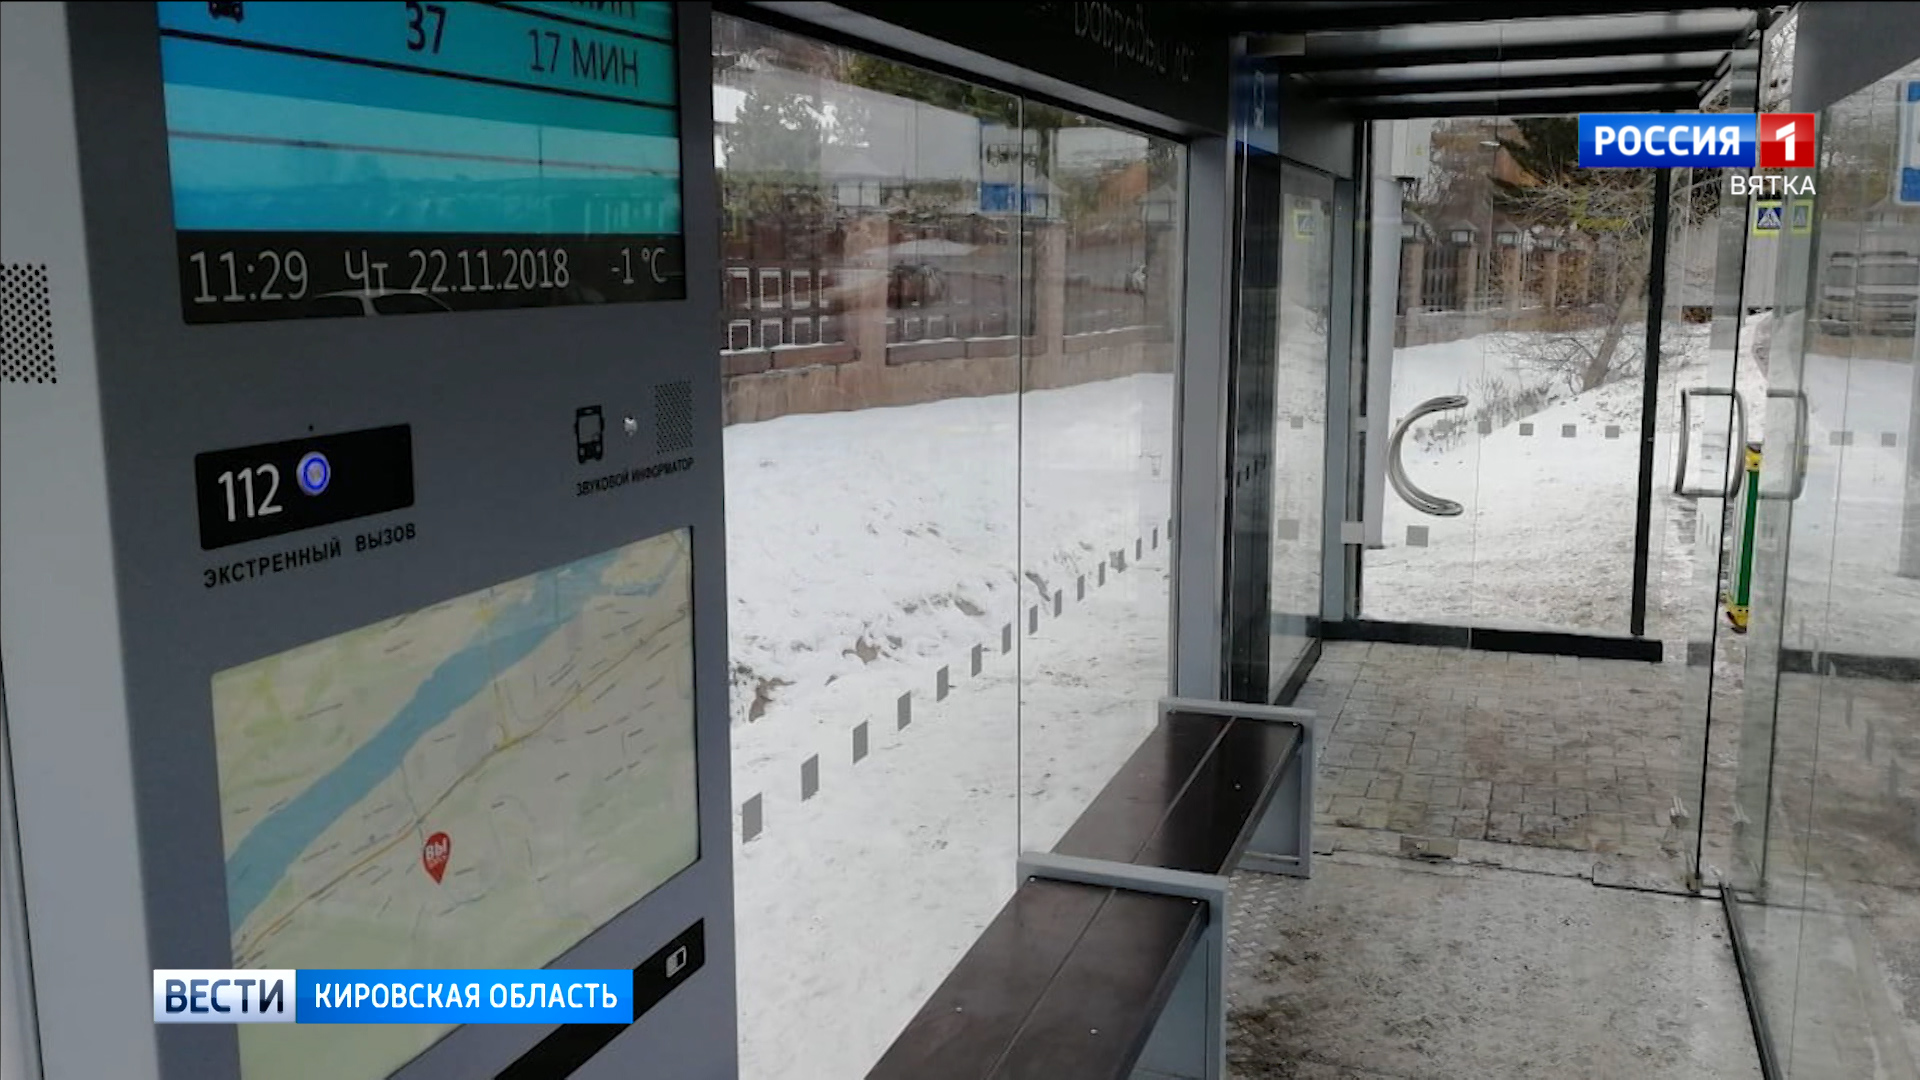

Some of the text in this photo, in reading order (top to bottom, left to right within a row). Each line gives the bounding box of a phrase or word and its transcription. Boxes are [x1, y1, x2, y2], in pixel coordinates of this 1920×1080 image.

[406, 4, 639, 87] 37 17 МИН
[188, 250, 309, 304] 11:29
[344, 250, 388, 295] Чт
[408, 248, 570, 294] 22.11.2018
[611, 247, 635, 285] -1
[217, 463, 283, 522] 112
[203, 522, 417, 588] ЭКСТРЕННЫЙ ВЫЗОВ
